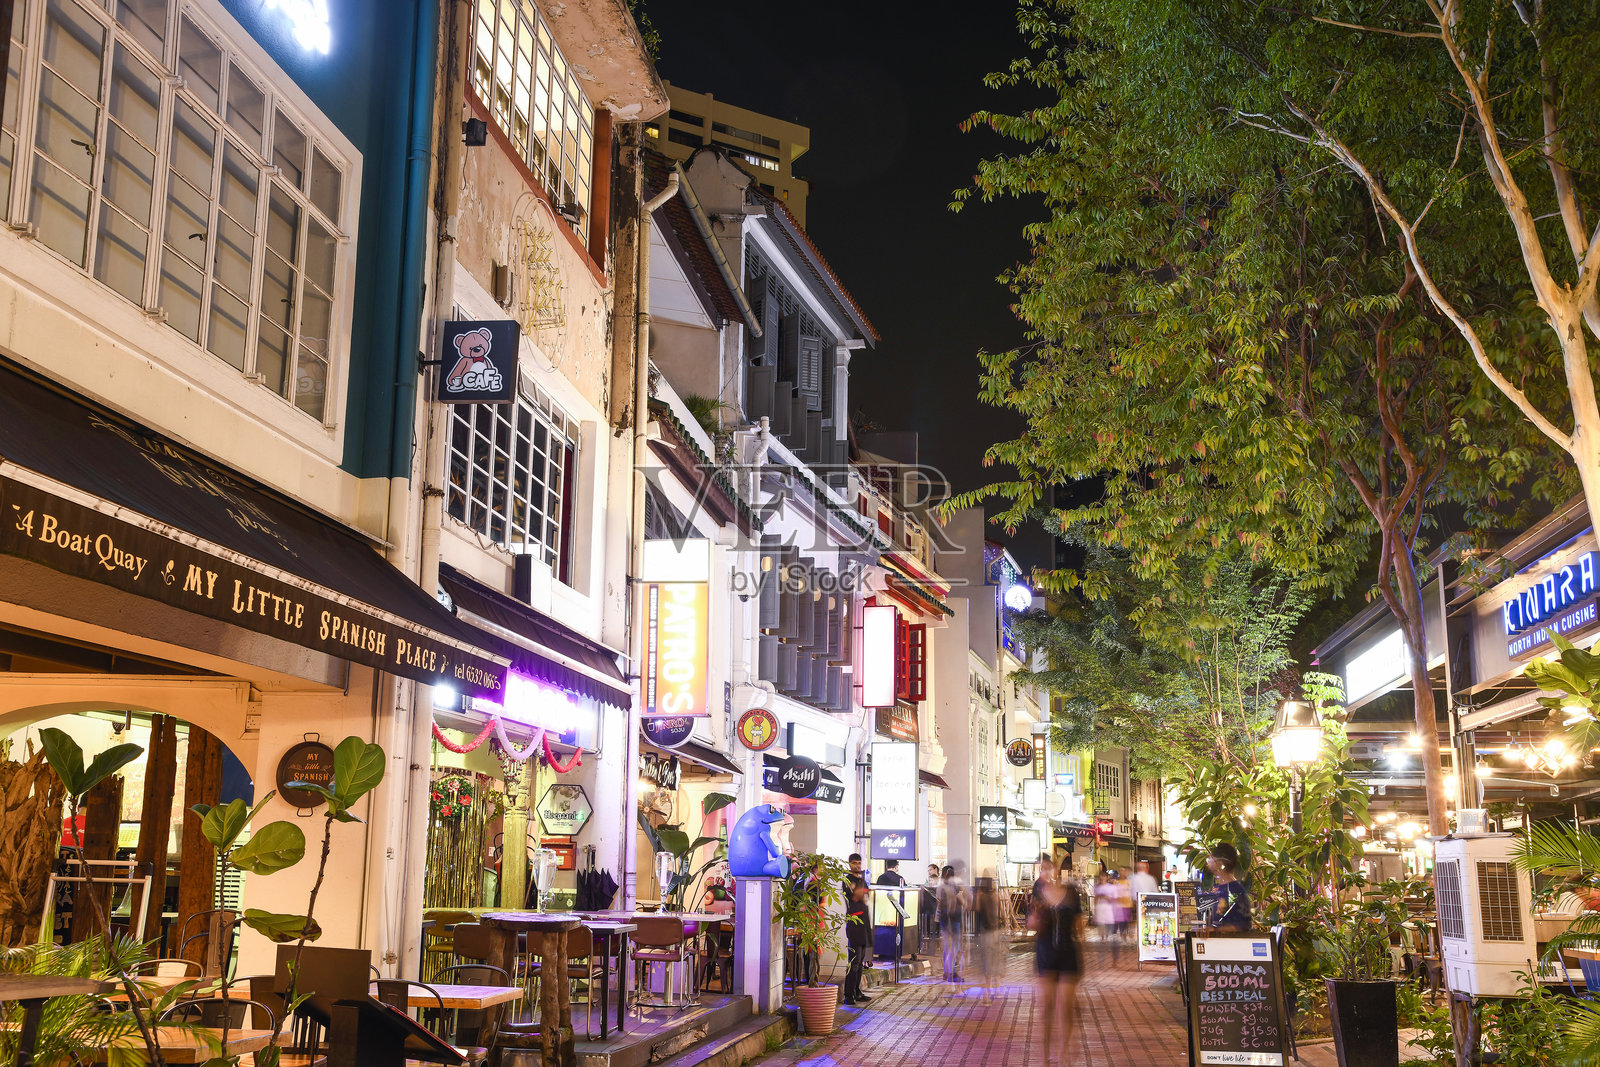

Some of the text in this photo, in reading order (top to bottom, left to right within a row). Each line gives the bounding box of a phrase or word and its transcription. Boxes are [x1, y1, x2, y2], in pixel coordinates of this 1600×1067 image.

[462, 368, 500, 390] CAFE
[38, 513, 93, 556] Boat
[95, 533, 148, 581] Quay
[183, 563, 219, 600] MY
[231, 579, 305, 629] LITTLE
[319, 610, 387, 656] SPANISH
[395, 638, 437, 672] PLACE
[454, 663, 465, 680] tel
[466, 665, 483, 687] 6532
[1503, 551, 1595, 636] KINARA
[1508, 635, 1532, 657] NORTH
[1561, 603, 1596, 632] CUISINE
[662, 583, 697, 714] PATRO'S
[306, 753, 319, 761] MY
[293, 772, 329, 781] SPANISH
[782, 767, 815, 783] Asahi
[879, 836, 907, 848] Asahi
[1200, 963, 1267, 977] KINARA
[1205, 975, 1270, 991] 500 ML
[1200, 990, 1267, 1002] BEST DEAL
[1198, 1003, 1242, 1013] TOWER
[1200, 1026, 1224, 1036] JUG
[1222, 1054, 1234, 1062] live
[1235, 1054, 1246, 1062] life
